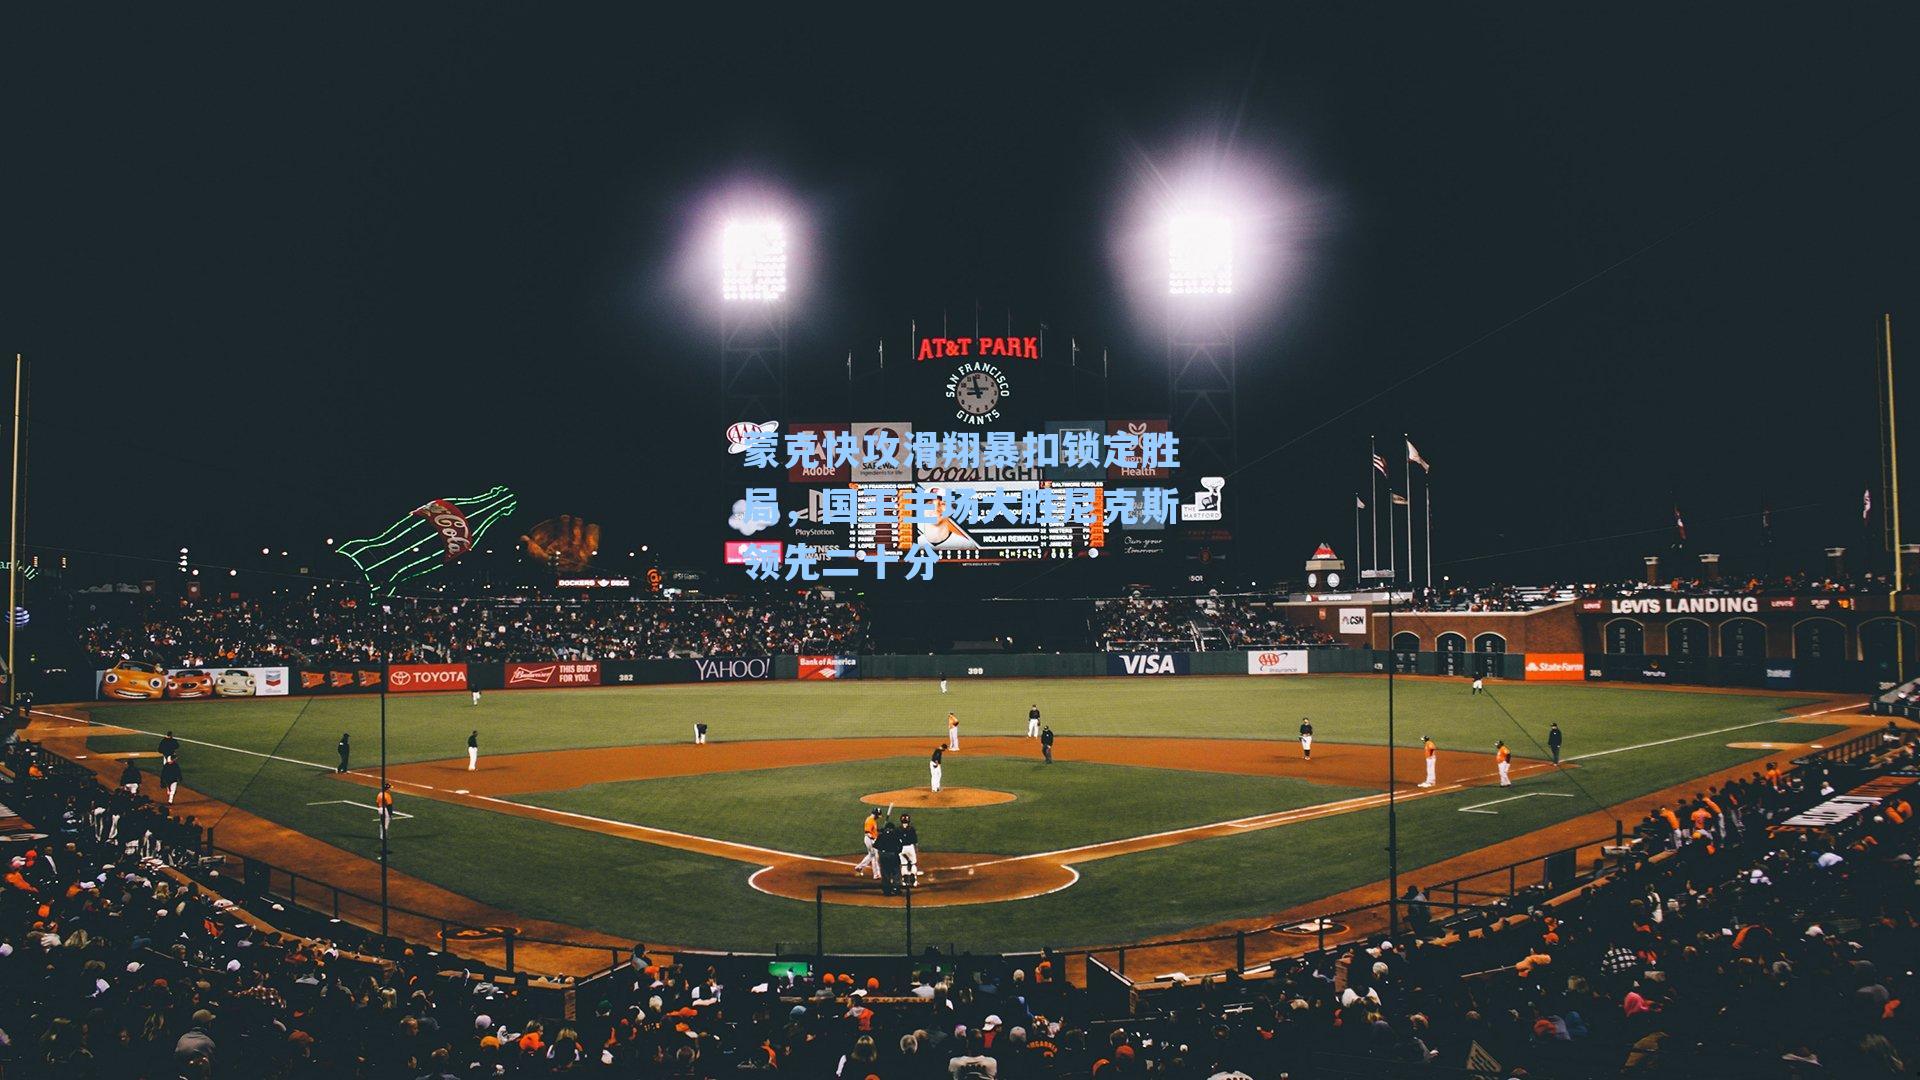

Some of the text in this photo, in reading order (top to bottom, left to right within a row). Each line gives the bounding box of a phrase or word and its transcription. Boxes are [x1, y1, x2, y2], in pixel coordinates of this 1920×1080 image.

[917, 337, 1038, 361] AT&T PARK
[945, 361, 1010, 398] SAN FRANCISCO
[956, 409, 1000, 425] GIANTS
[802, 466, 836, 476] Adobe
[1121, 467, 1156, 476] Health
[795, 528, 835, 537] PlayStation
[983, 535, 1007, 543] NOLAN
[1124, 536, 1142, 545] Own
[558, 579, 630, 587] DOCKERS DECK
[1665, 597, 1758, 613] LANDING
[1349, 615, 1364, 625] CSN
[800, 658, 857, 666] Bank of America
[1119, 654, 1175, 675] VISA
[1561, 662, 1584, 672] Farm
[559, 664, 598, 674] THIS BUD'S
[695, 658, 771, 681] YAHOO!
[413, 671, 466, 683] TOYOTA
[559, 674, 573, 683] FOR
